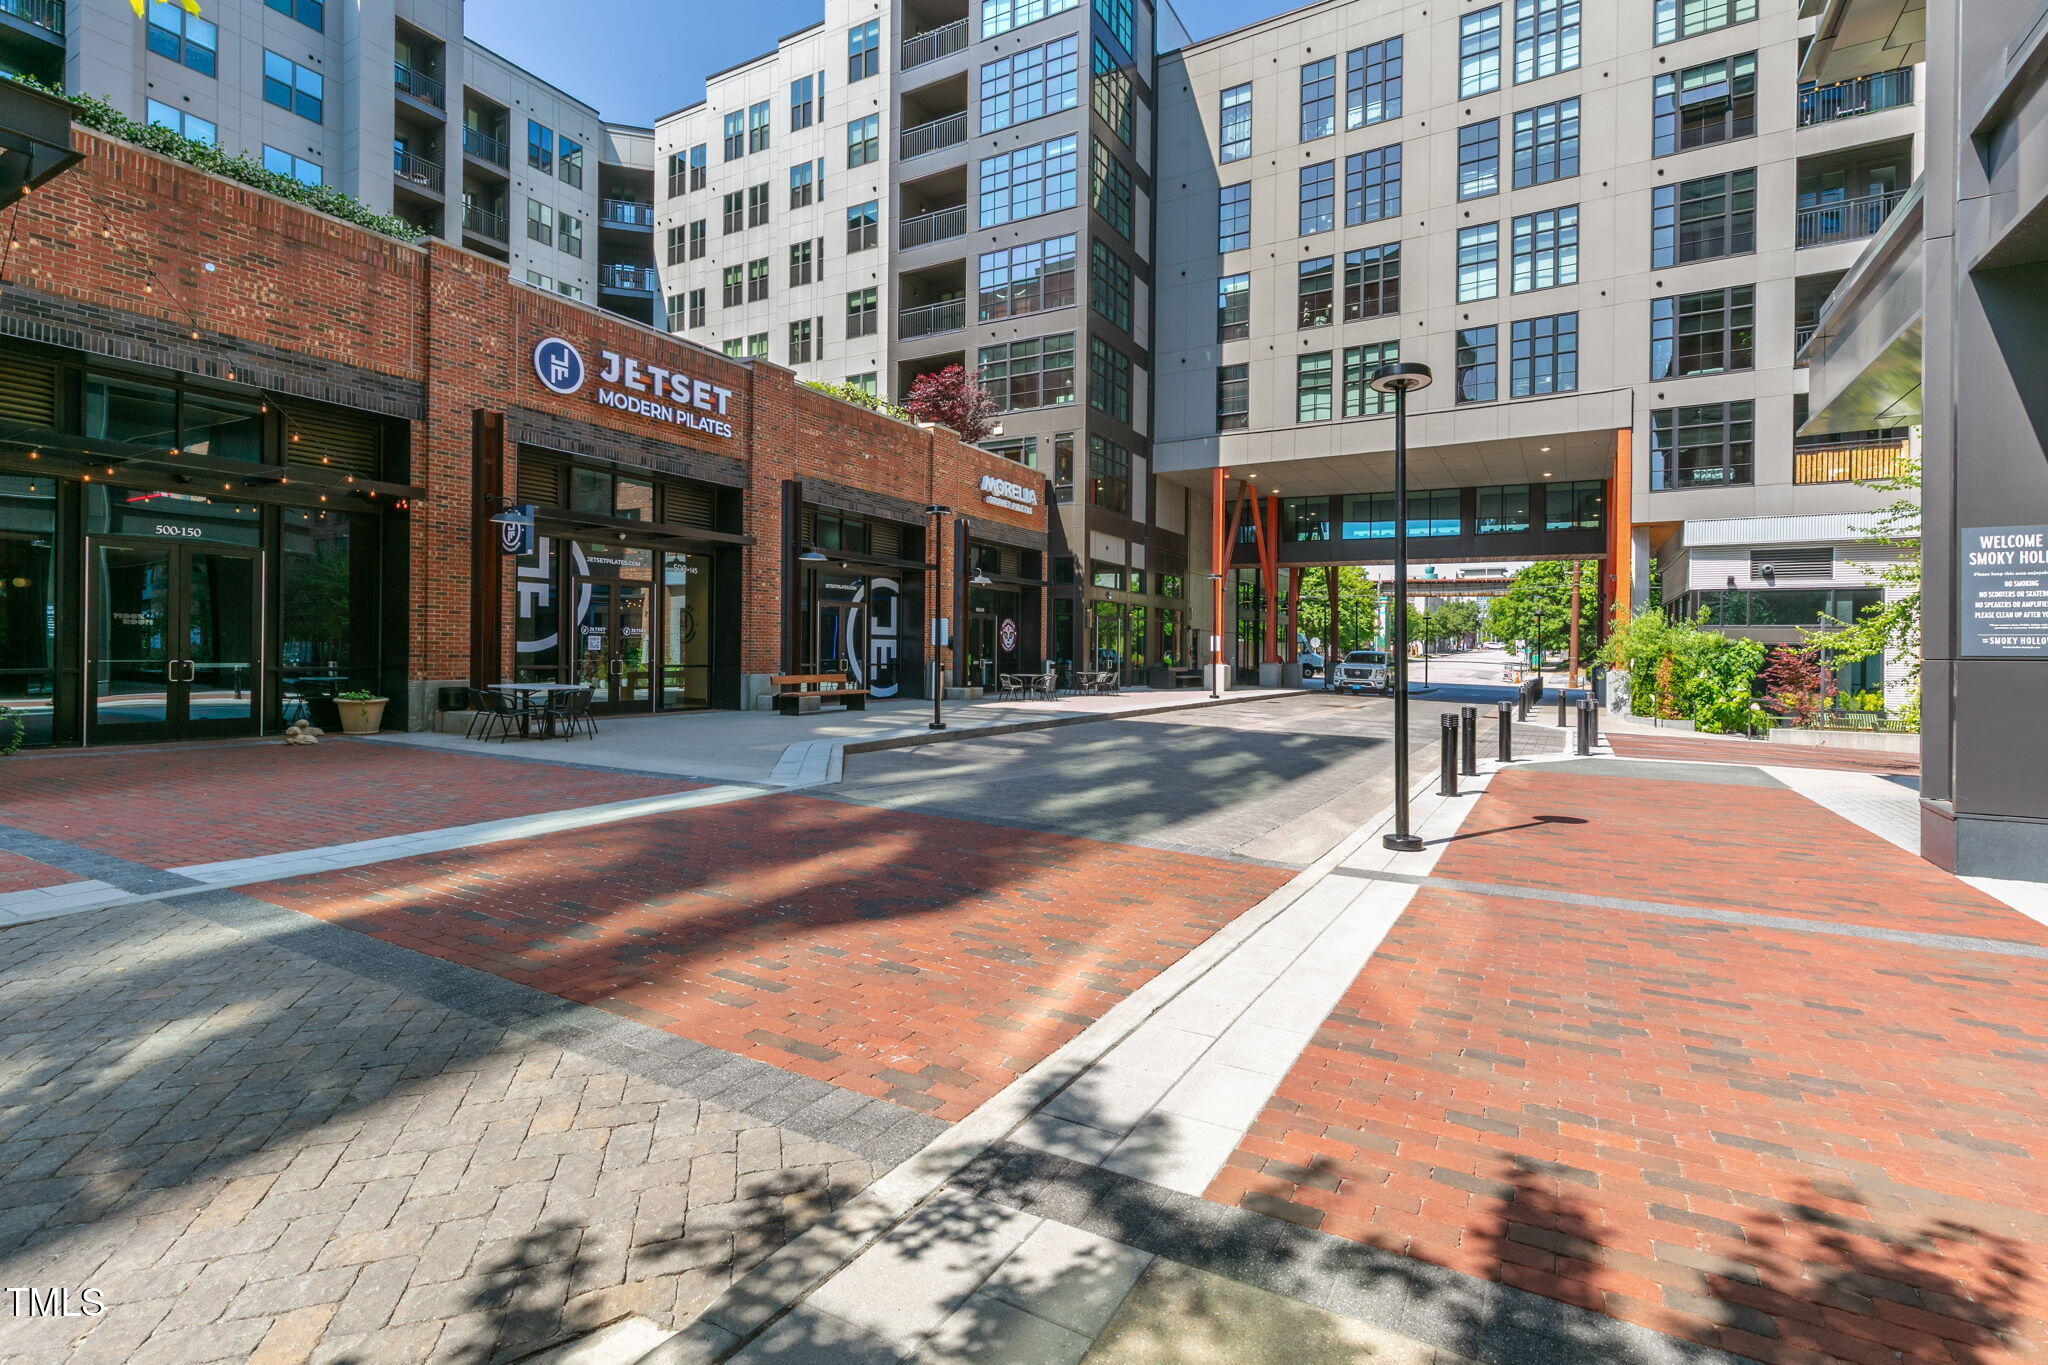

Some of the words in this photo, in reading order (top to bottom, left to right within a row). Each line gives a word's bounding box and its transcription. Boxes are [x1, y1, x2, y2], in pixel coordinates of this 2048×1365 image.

[600, 351, 732, 415] JETSET
[599, 388, 672, 423] MODERN
[675, 410, 732, 438] PILATES
[980, 475, 1037, 505] MORELIA
[155, 525, 201, 537] 500-150
[1980, 534, 2043, 549] WELCOME
[587, 556, 640, 567] JETSETPILATES.COM
[1969, 551, 2015, 566] SMOKY
[1974, 611, 1994, 619] PLEASE
[1989, 636, 2018, 645] SMOKY
